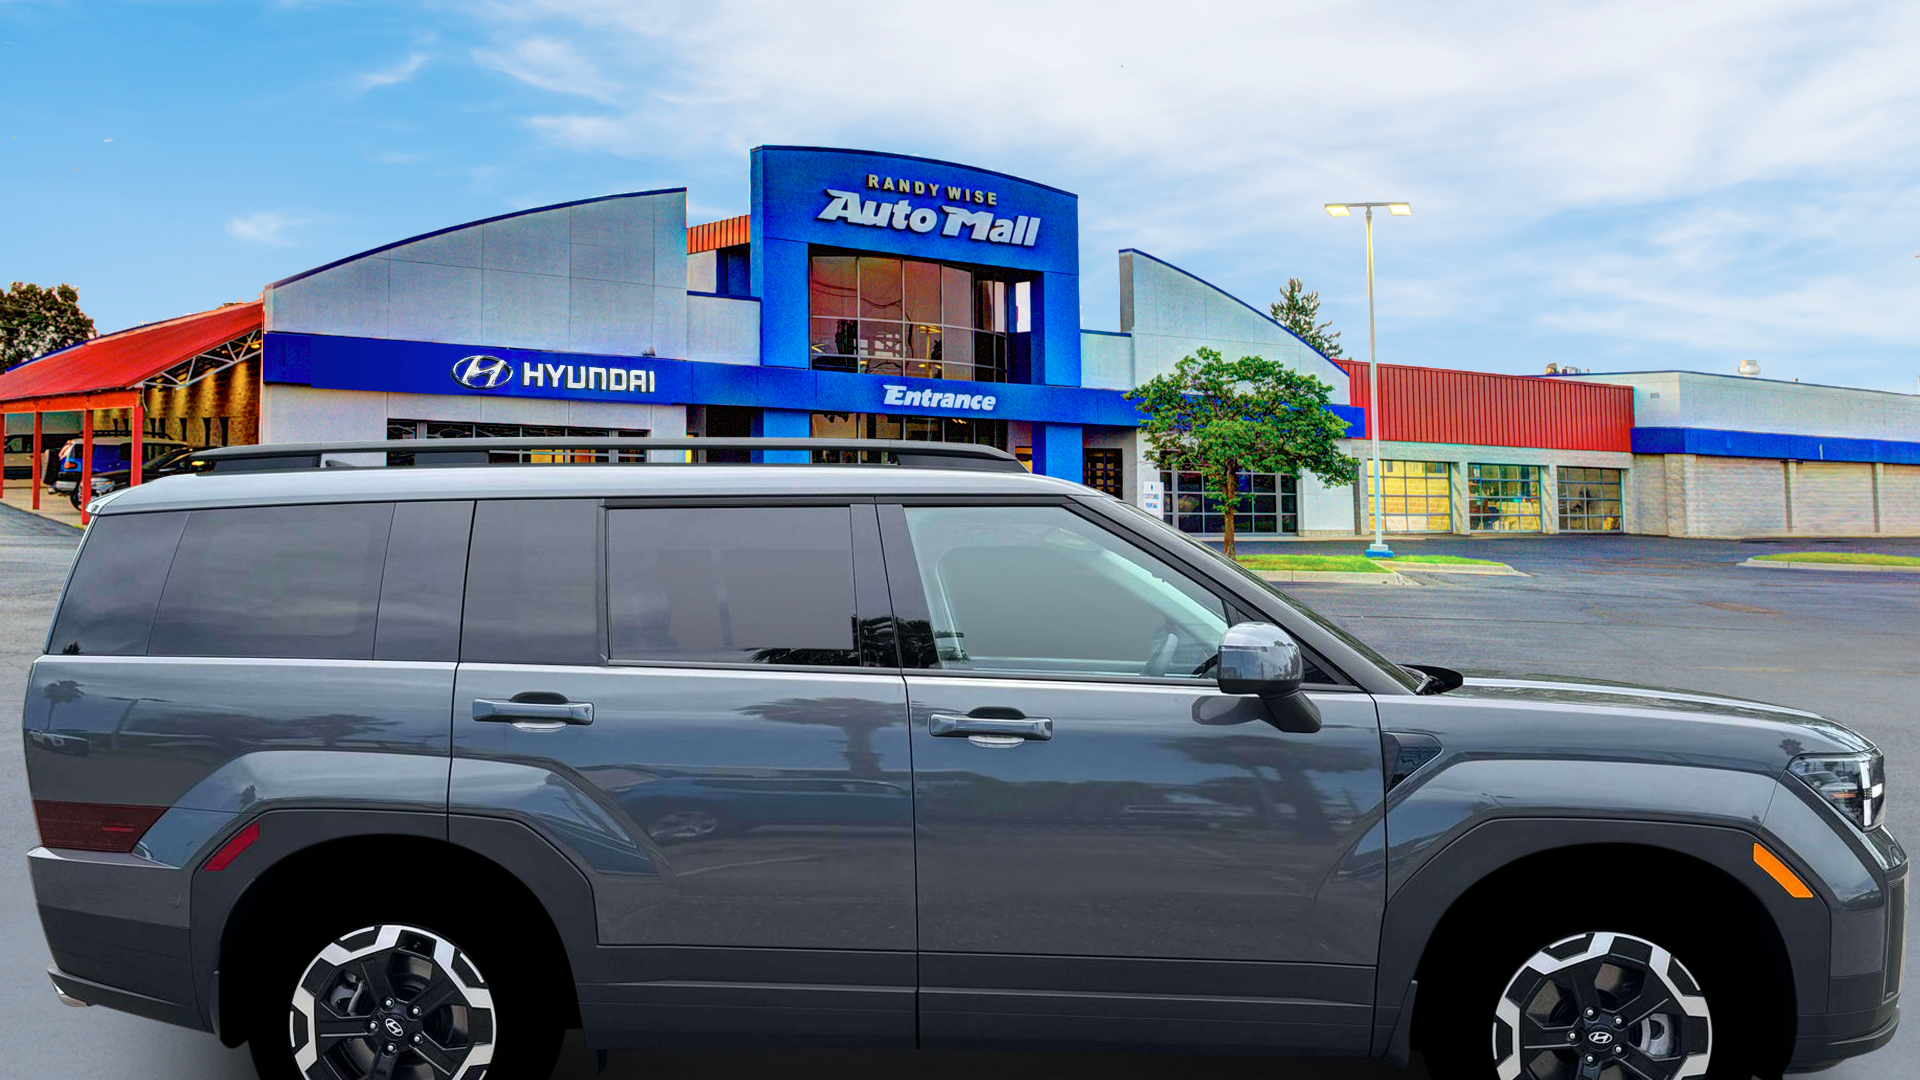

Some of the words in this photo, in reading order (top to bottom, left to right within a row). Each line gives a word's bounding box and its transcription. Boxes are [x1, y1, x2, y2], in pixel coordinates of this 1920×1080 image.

[867, 174, 939, 196] RANDY
[946, 186, 997, 206] WISE
[817, 189, 938, 233] Auto
[941, 205, 1041, 247] Mall
[522, 362, 655, 393] HYUNDAI
[883, 384, 996, 411] Entrance
